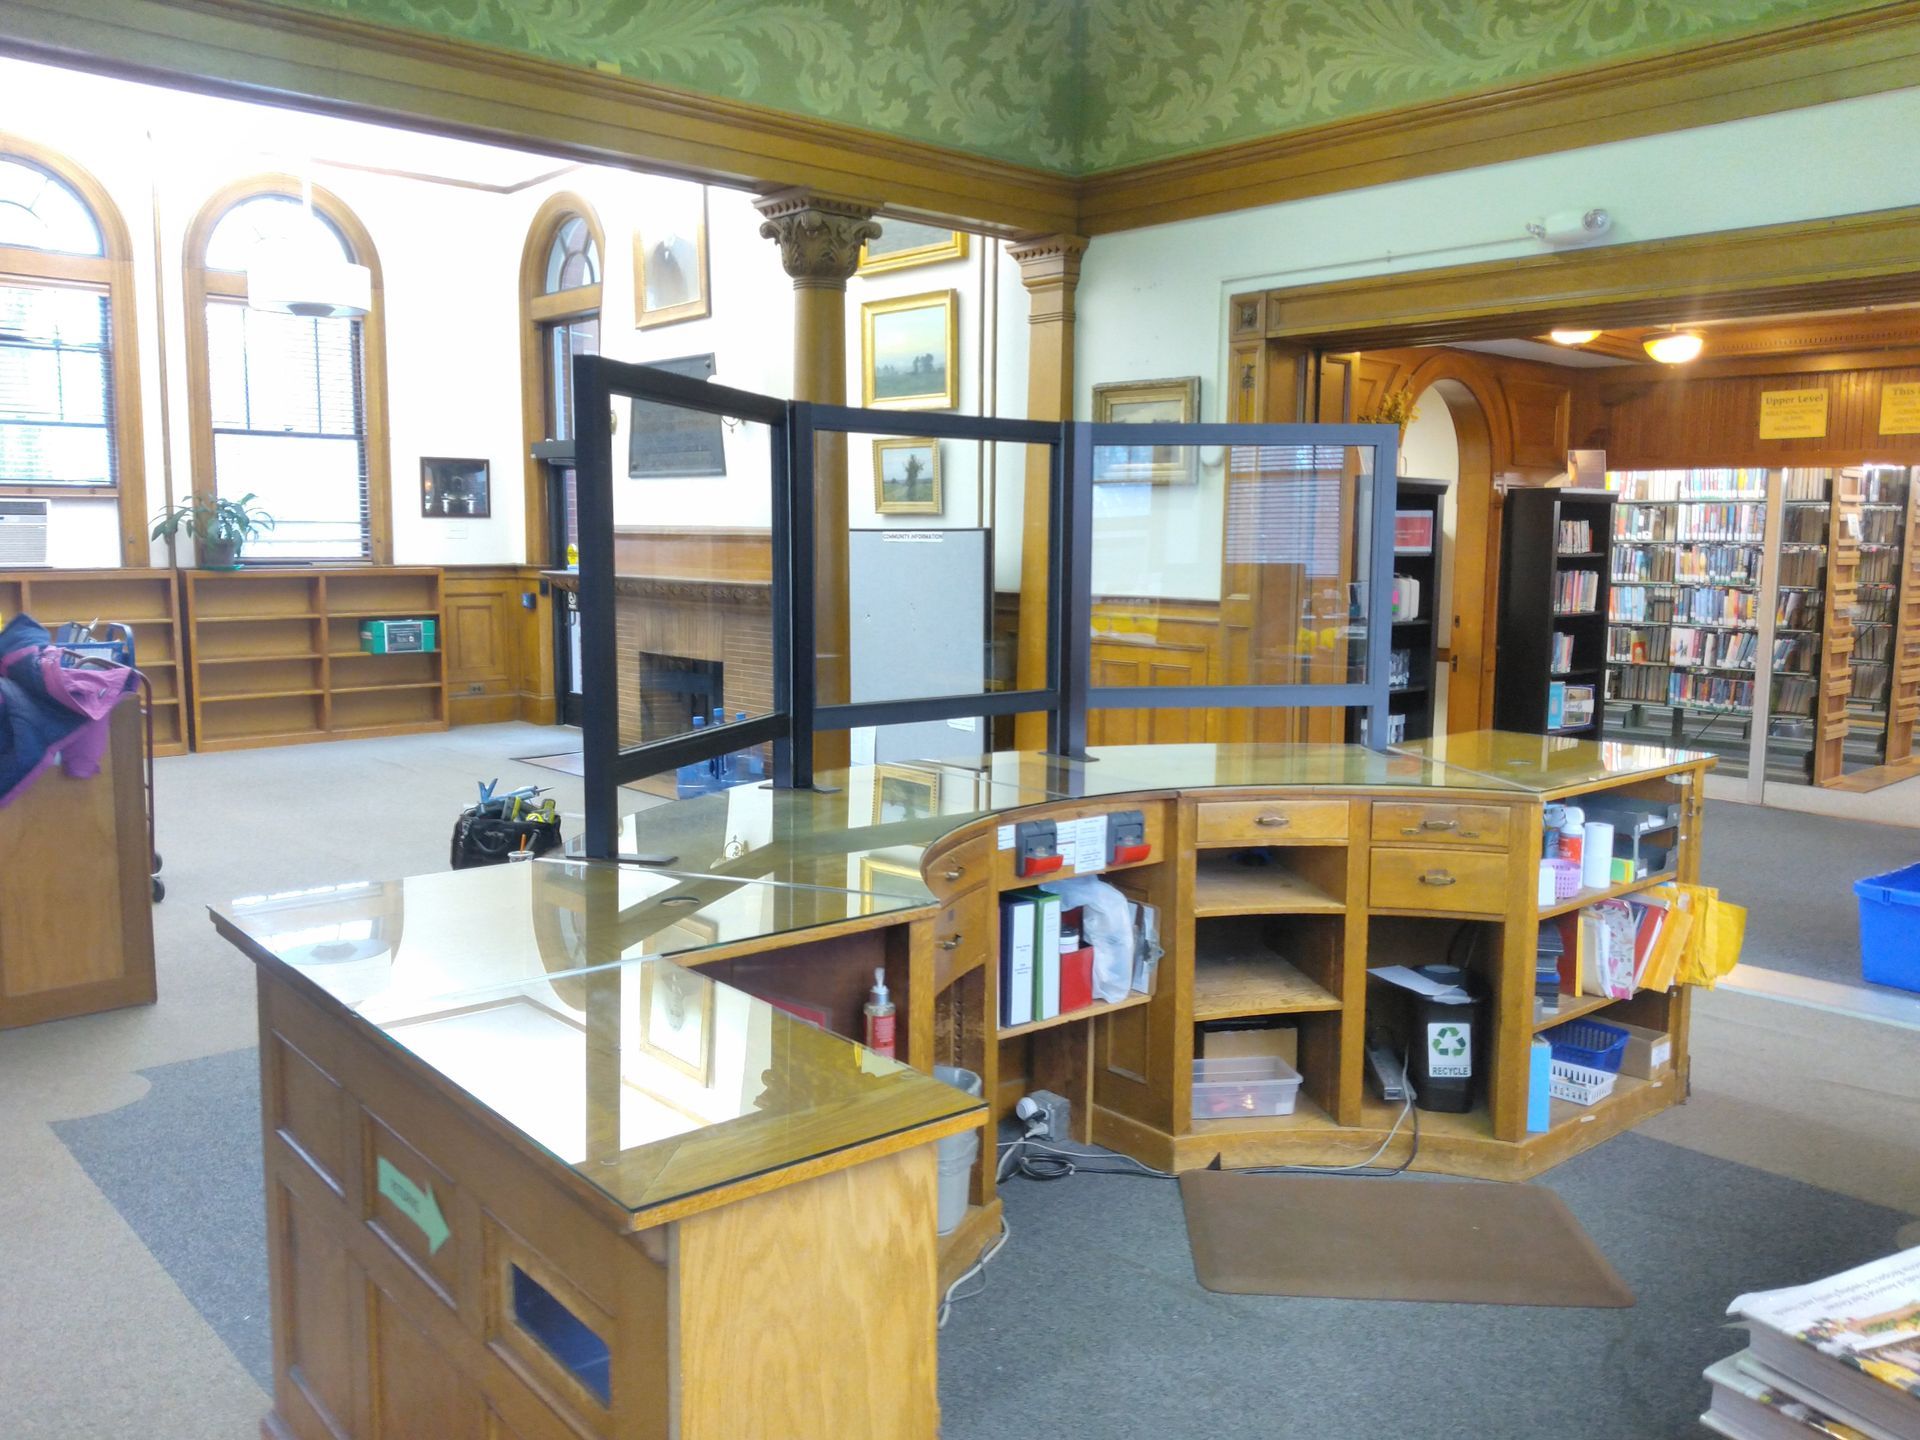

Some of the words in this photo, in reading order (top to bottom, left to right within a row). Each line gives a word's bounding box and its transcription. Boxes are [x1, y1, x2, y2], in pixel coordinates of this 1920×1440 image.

[1766, 397, 1794, 406] Upper
[1798, 393, 1824, 403] Level
[1432, 1067, 1468, 1076] RECYCLE
